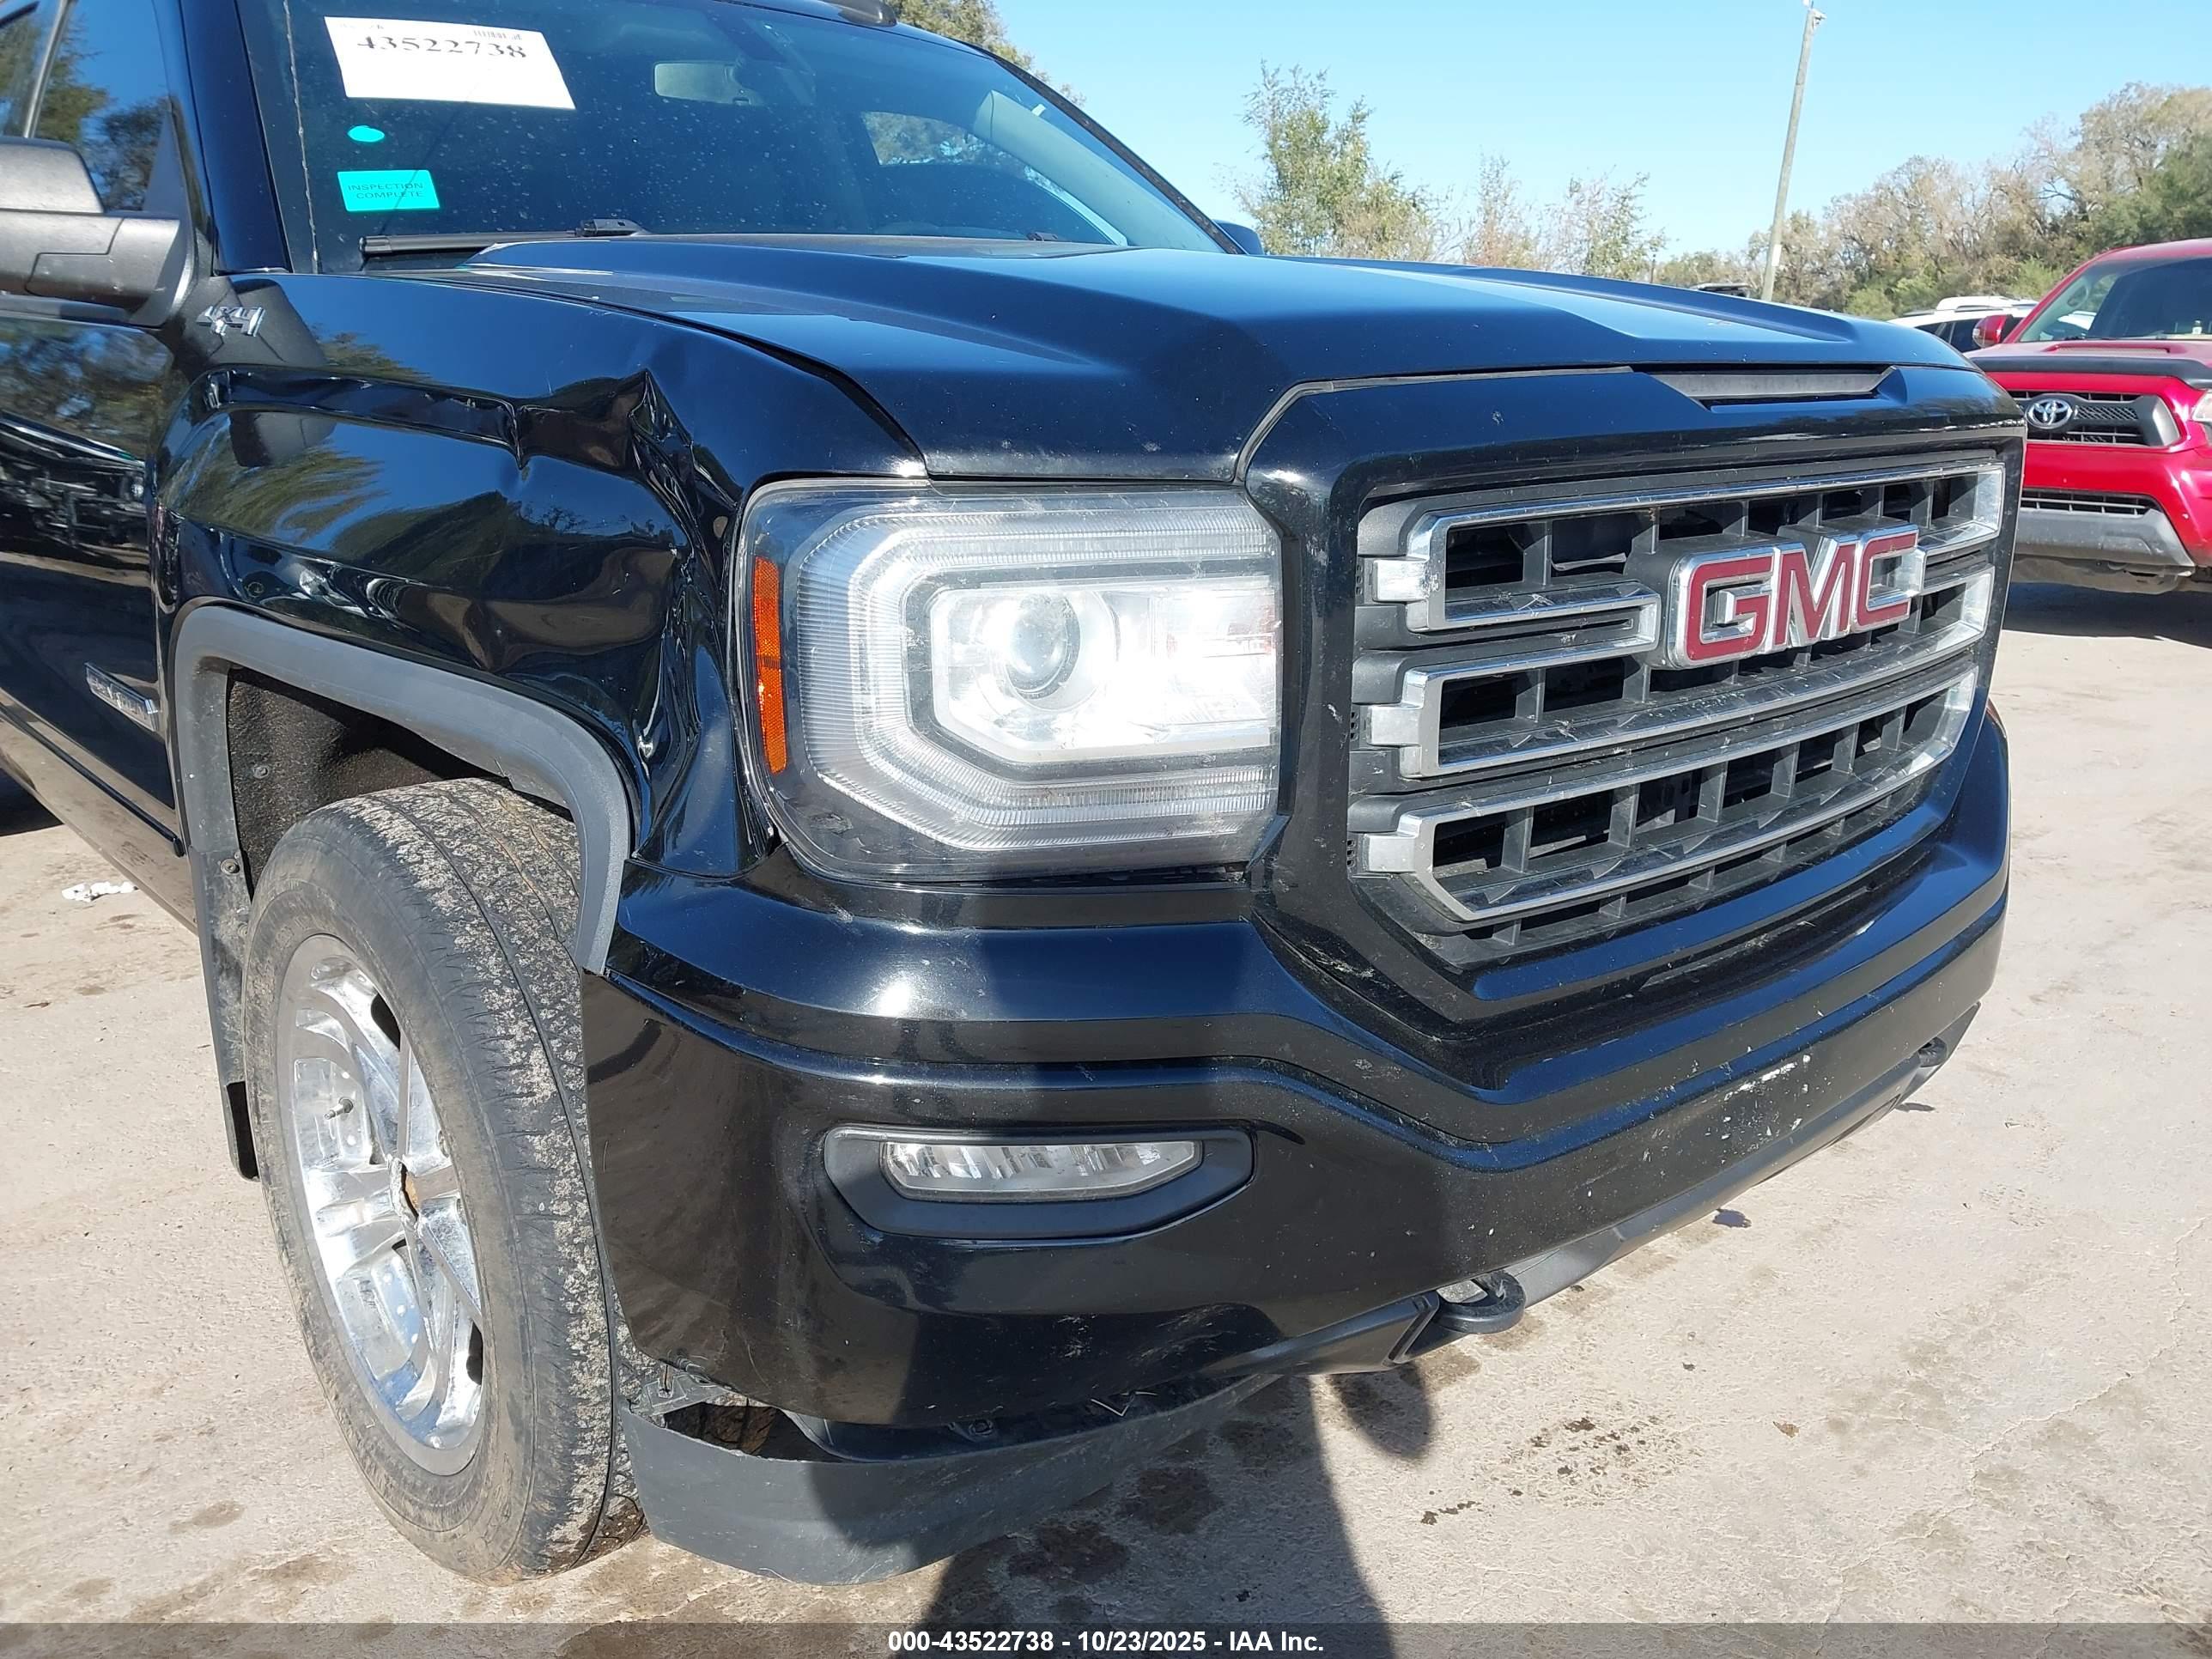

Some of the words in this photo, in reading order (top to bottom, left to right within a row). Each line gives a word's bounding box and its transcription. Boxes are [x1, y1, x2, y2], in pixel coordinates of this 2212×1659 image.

[357, 36, 527, 58] 43522738
[348, 182, 423, 191] INSPECTION
[356, 191, 424, 199] COMPLETE
[1673, 525, 1920, 668] GMC
